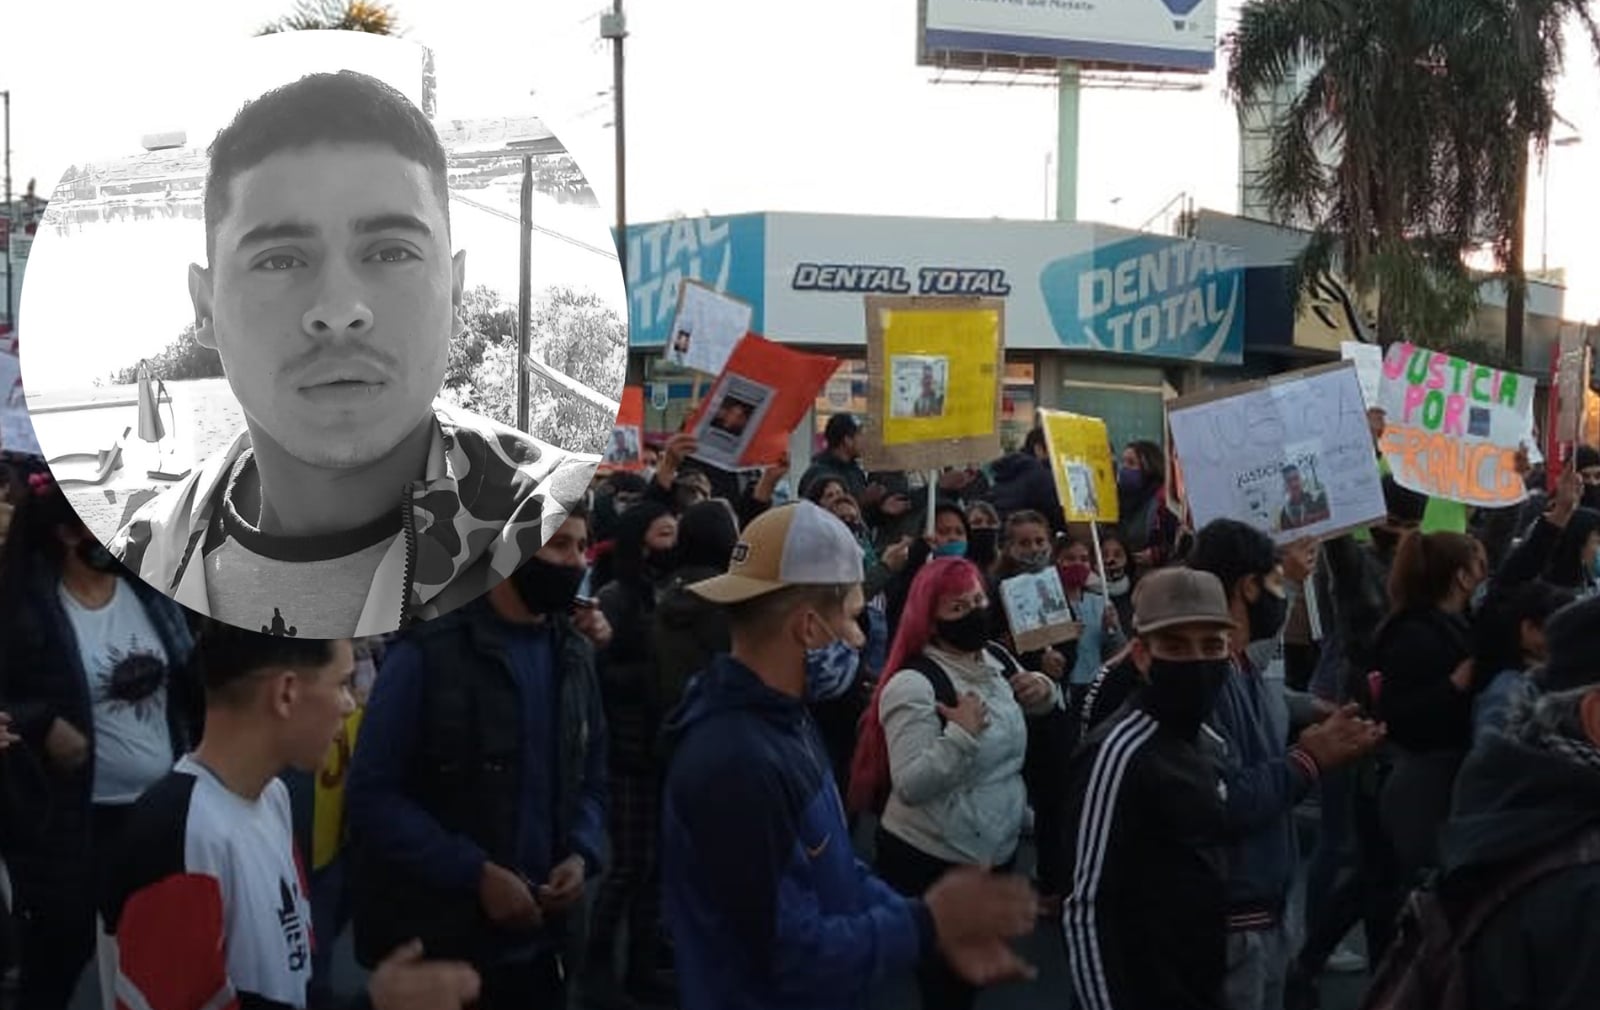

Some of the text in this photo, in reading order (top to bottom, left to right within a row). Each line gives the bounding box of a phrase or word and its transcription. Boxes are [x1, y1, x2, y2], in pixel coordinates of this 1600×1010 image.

[793, 264, 1011, 296] DENTAL TOTAL
[1107, 281, 1226, 351] TOTAL
[1384, 340, 1519, 408] JUSTICIA
[1403, 383, 1466, 437] POR
[1378, 425, 1523, 502] FRANCO
